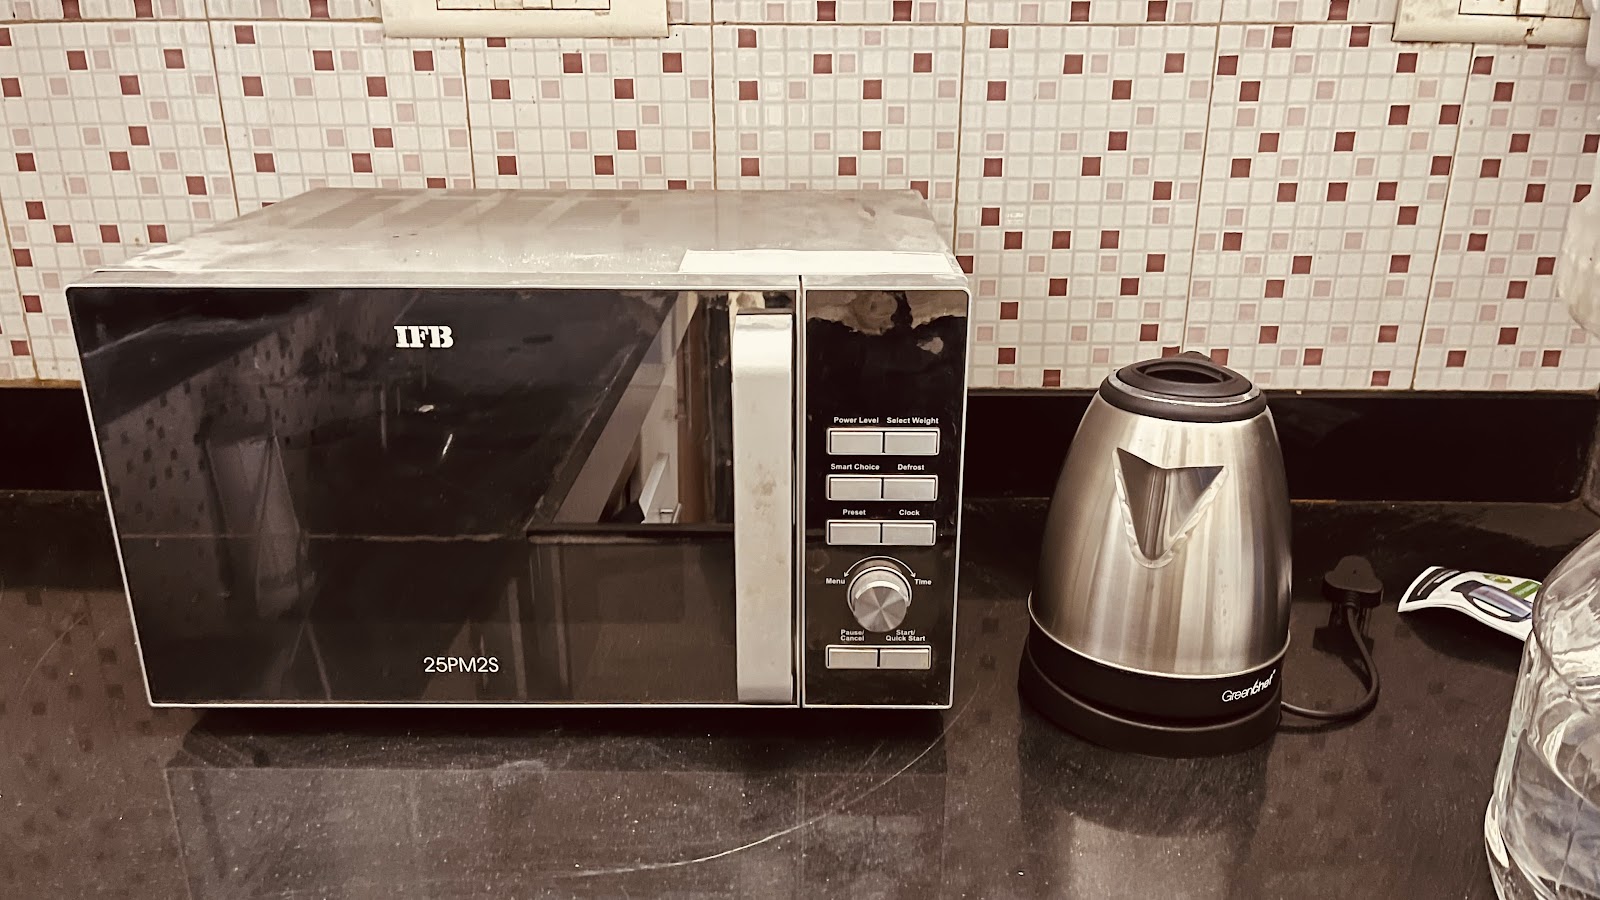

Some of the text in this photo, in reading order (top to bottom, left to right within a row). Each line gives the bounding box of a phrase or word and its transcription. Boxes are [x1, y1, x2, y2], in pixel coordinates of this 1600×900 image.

[393, 325, 454, 348] IFB
[833, 416, 879, 424] Power Level
[886, 416, 939, 426] Select Weight
[830, 463, 880, 471] Smart Choice
[897, 463, 925, 471] Defrost
[842, 508, 866, 516] Preset
[899, 509, 920, 517] Clock
[825, 577, 846, 585] Menu
[914, 578, 932, 586] Time
[423, 657, 499, 673] 25PM2S
